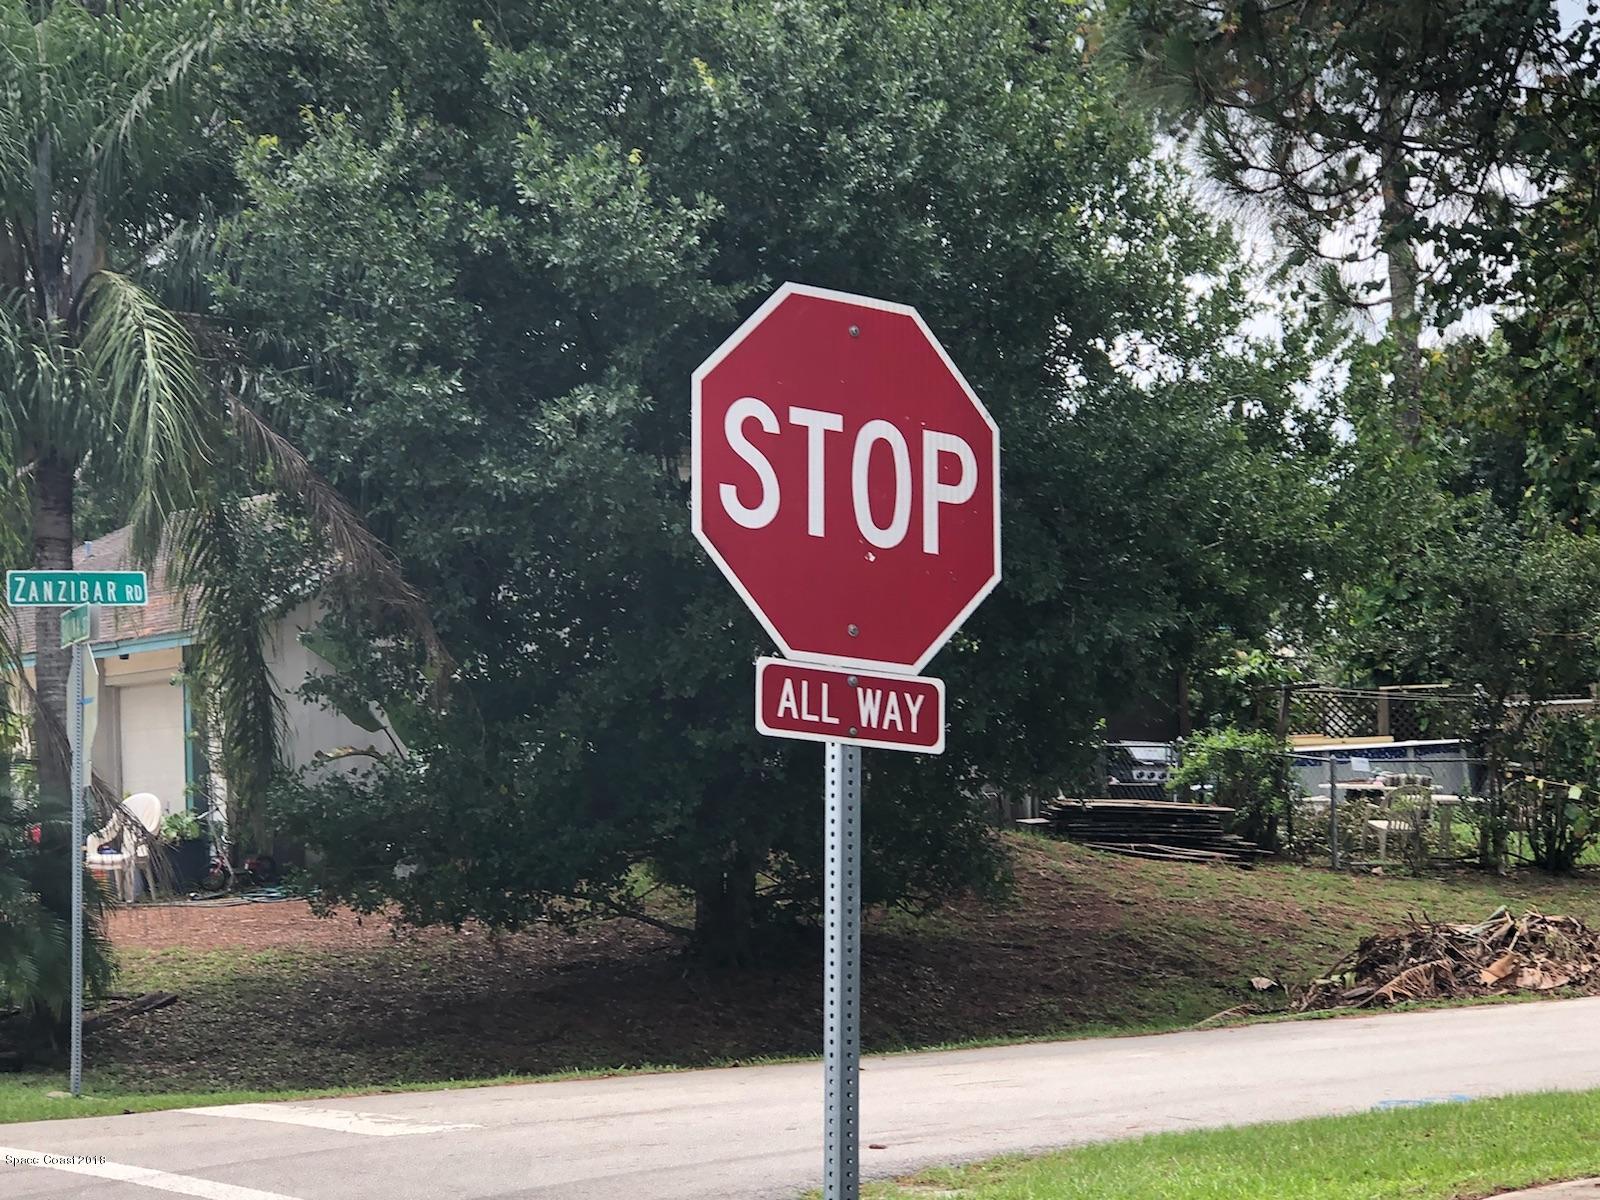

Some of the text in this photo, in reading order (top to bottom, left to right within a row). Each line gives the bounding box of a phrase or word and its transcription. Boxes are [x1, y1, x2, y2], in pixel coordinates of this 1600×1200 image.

[719, 397, 978, 555] STOP
[14, 576, 143, 602] ZANZIBAR RD
[777, 678, 925, 733] ALL WAY
